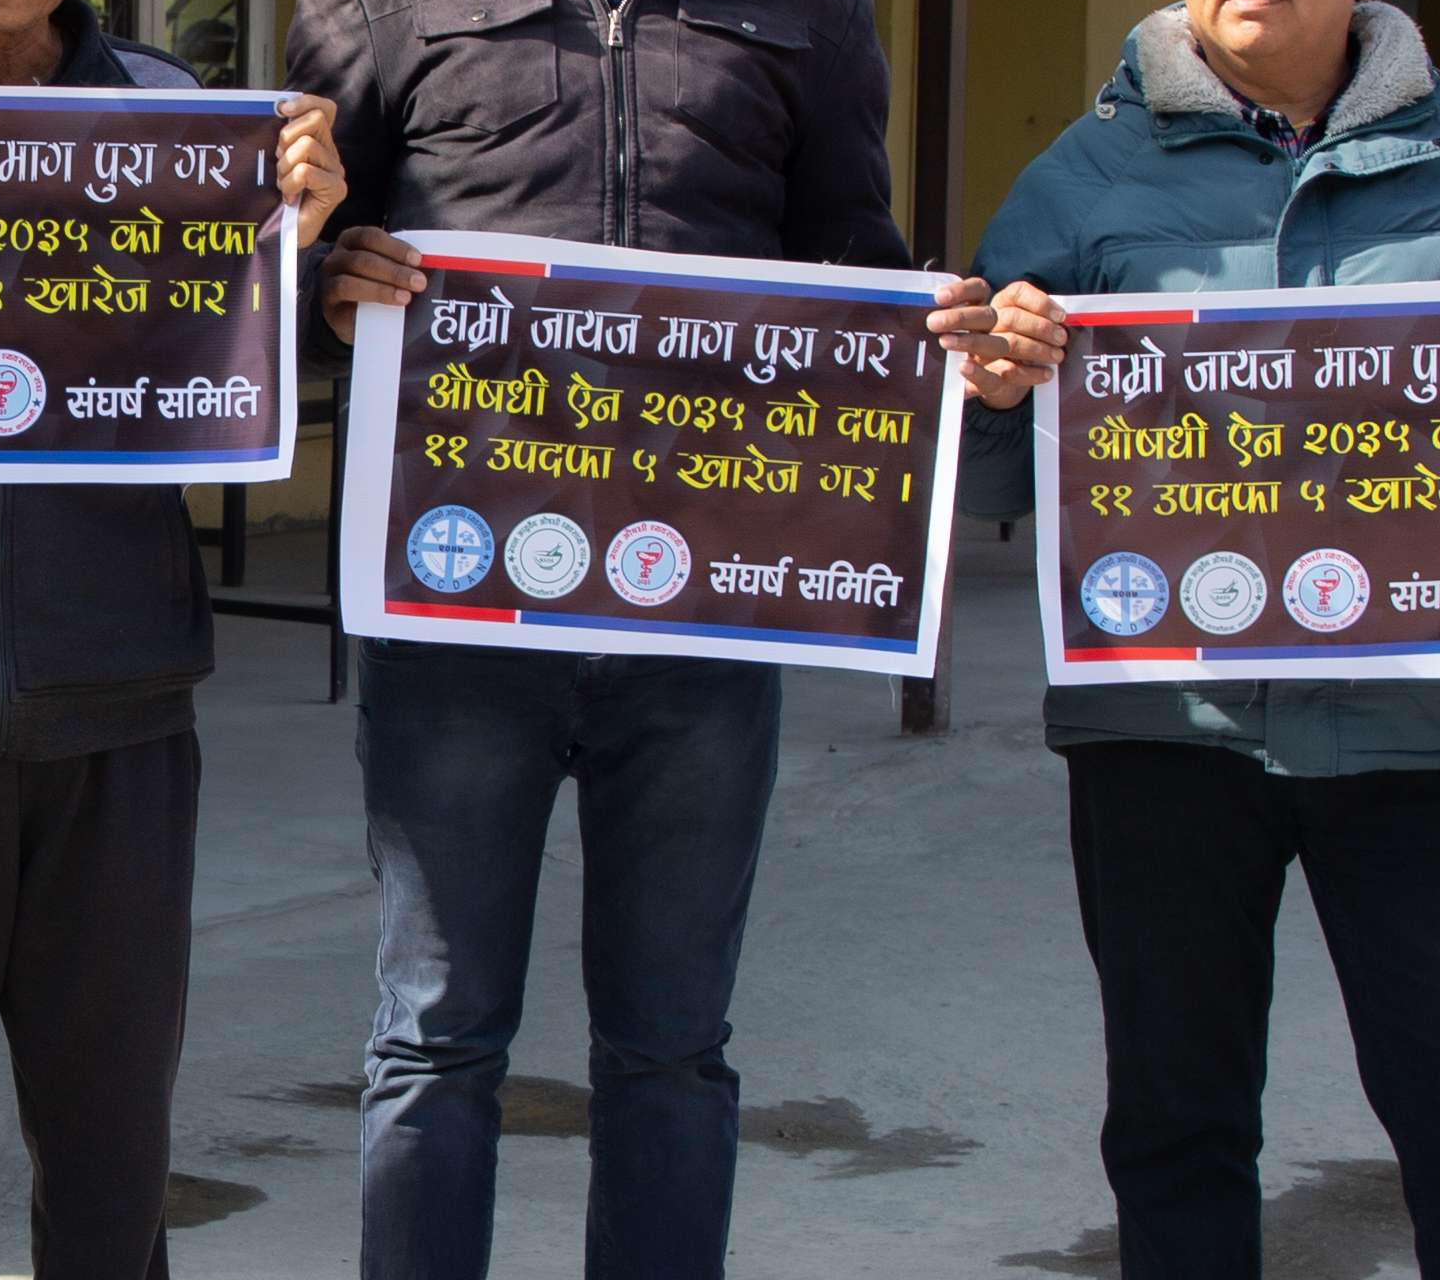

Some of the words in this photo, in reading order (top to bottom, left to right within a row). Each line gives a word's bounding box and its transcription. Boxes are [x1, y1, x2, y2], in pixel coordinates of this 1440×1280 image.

[84, 141, 158, 203] पुरा
[174, 144, 234, 189] गर
[110, 206, 165, 254] को
[182, 221, 255, 257] दफा
[24, 264, 149, 315] खारेज
[169, 280, 225, 316] गर
[430, 285, 515, 352] हाम्रो
[530, 306, 643, 355] जायज
[657, 316, 739, 362] माग
[743, 323, 819, 384] पुरा
[834, 330, 895, 378] गर
[65, 376, 150, 419] संघर्ष
[156, 375, 262, 419] समिति
[1082, 335, 1167, 404] हाम्रो
[1182, 348, 1297, 393] जायज
[1313, 345, 1395, 389] माग
[426, 362, 549, 417] औषधी
[567, 371, 623, 430] ऐन
[640, 392, 746, 433] २०३५
[765, 389, 821, 437] को
[836, 406, 913, 445] दफा
[424, 433, 469, 469] ११
[486, 438, 613, 480] उपदफा
[676, 443, 801, 493] खारेज
[819, 464, 877, 502] गर
[1087, 412, 1209, 461] औषधी
[1227, 410, 1282, 468] ऐन
[1303, 419, 1410, 459] २०३५
[1089, 484, 1134, 517] ११
[1153, 481, 1281, 518] उपदफा
[709, 553, 794, 597] संघर्ष
[798, 559, 904, 608] समिति
